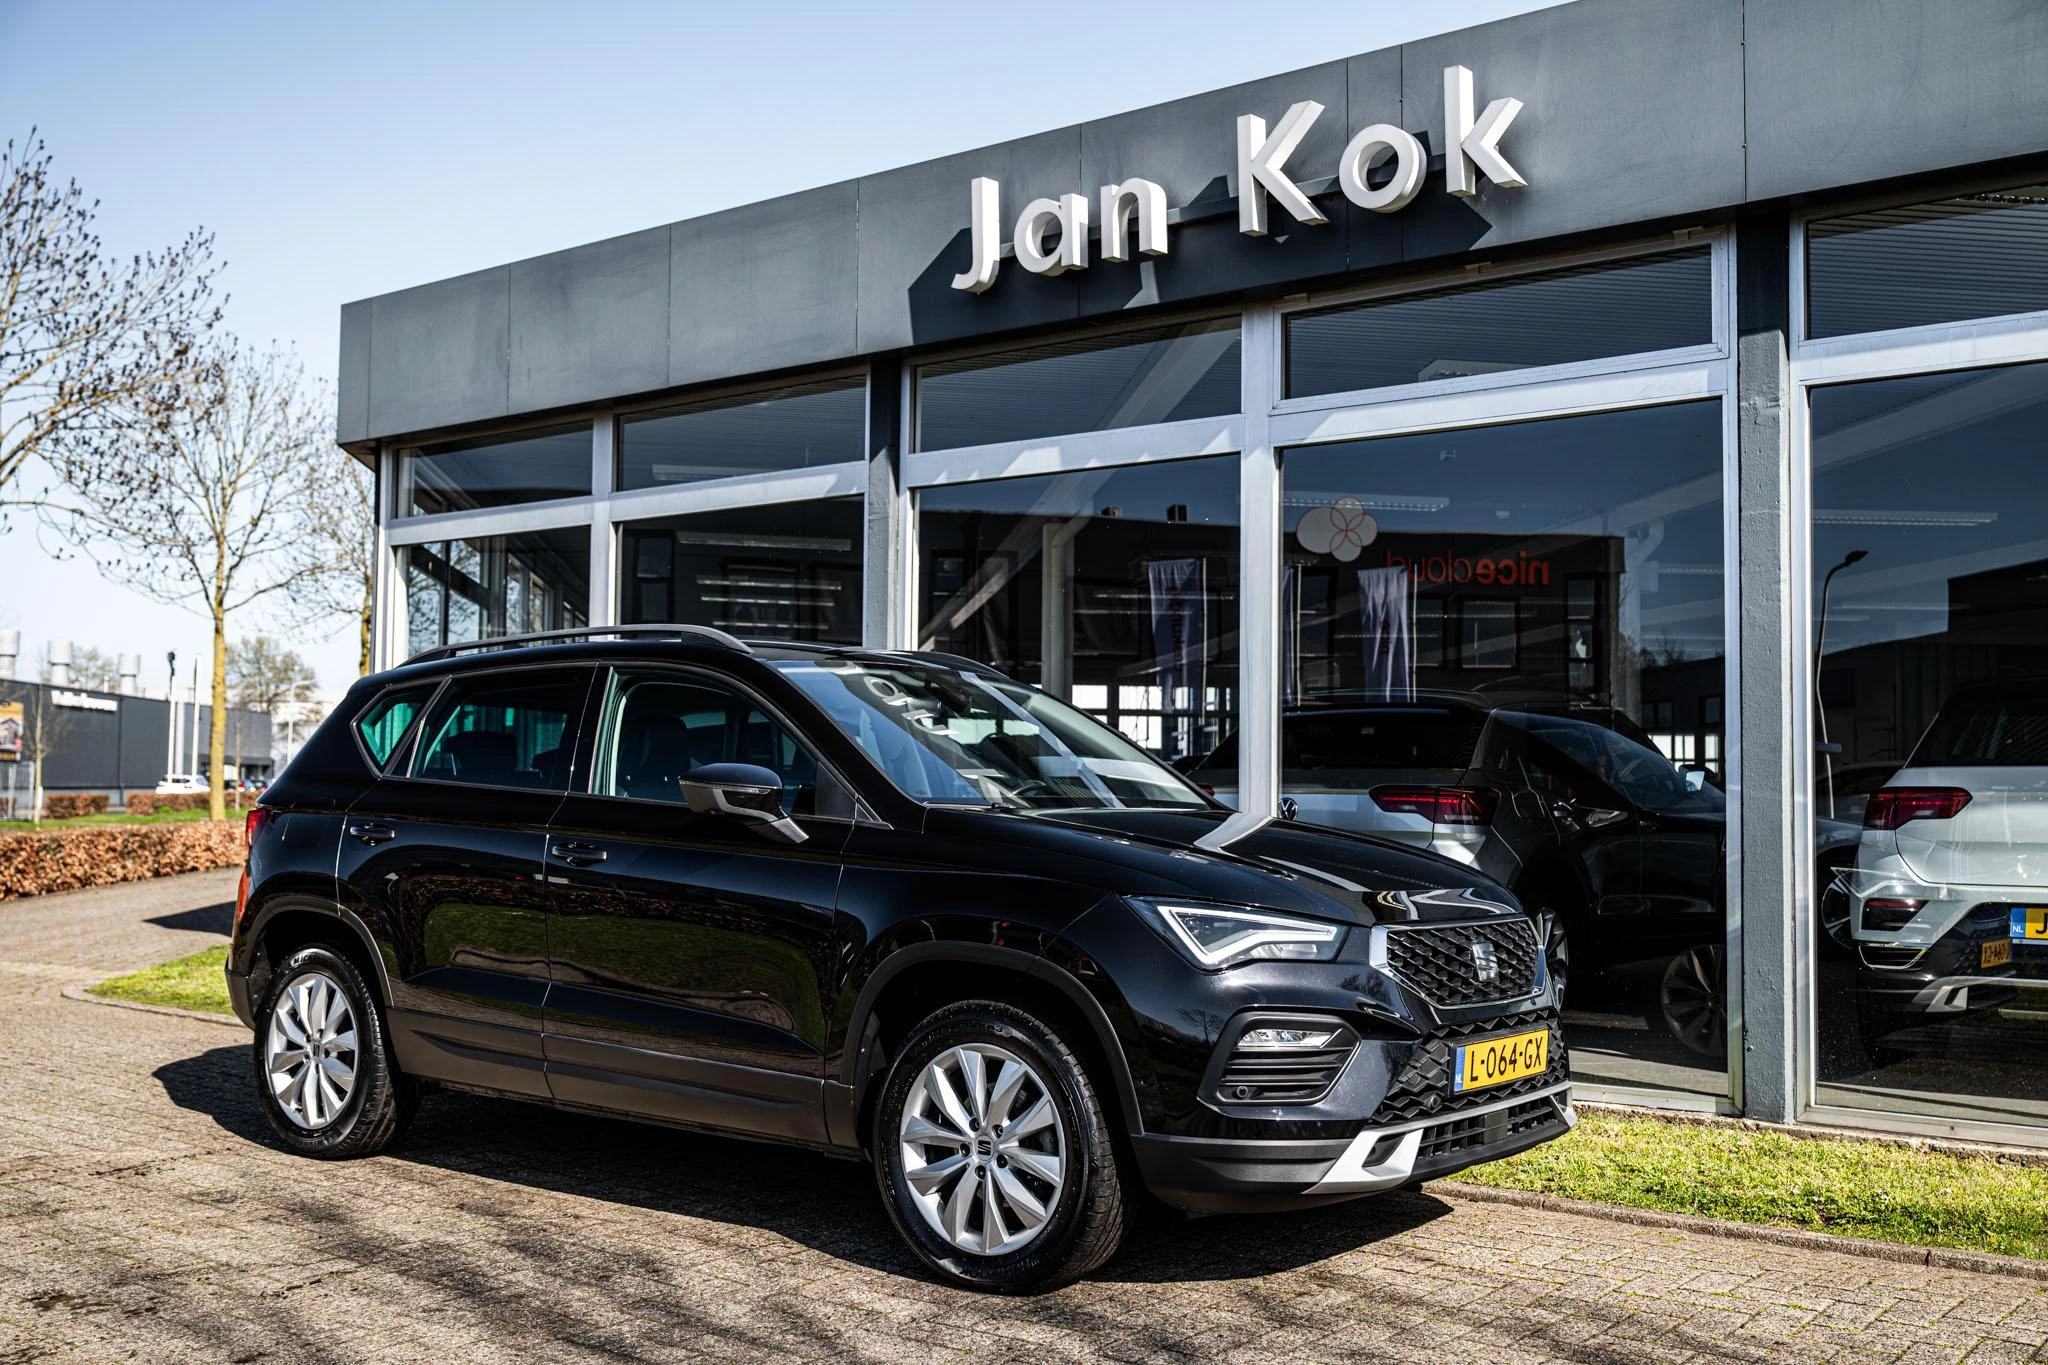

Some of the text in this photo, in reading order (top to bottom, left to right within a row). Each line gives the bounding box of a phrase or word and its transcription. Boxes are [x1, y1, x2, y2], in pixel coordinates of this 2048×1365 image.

[951, 64, 1528, 294] Jan Kok
[2012, 925, 2023, 933] NL
[1470, 1036, 1543, 1082] L-064-GX
